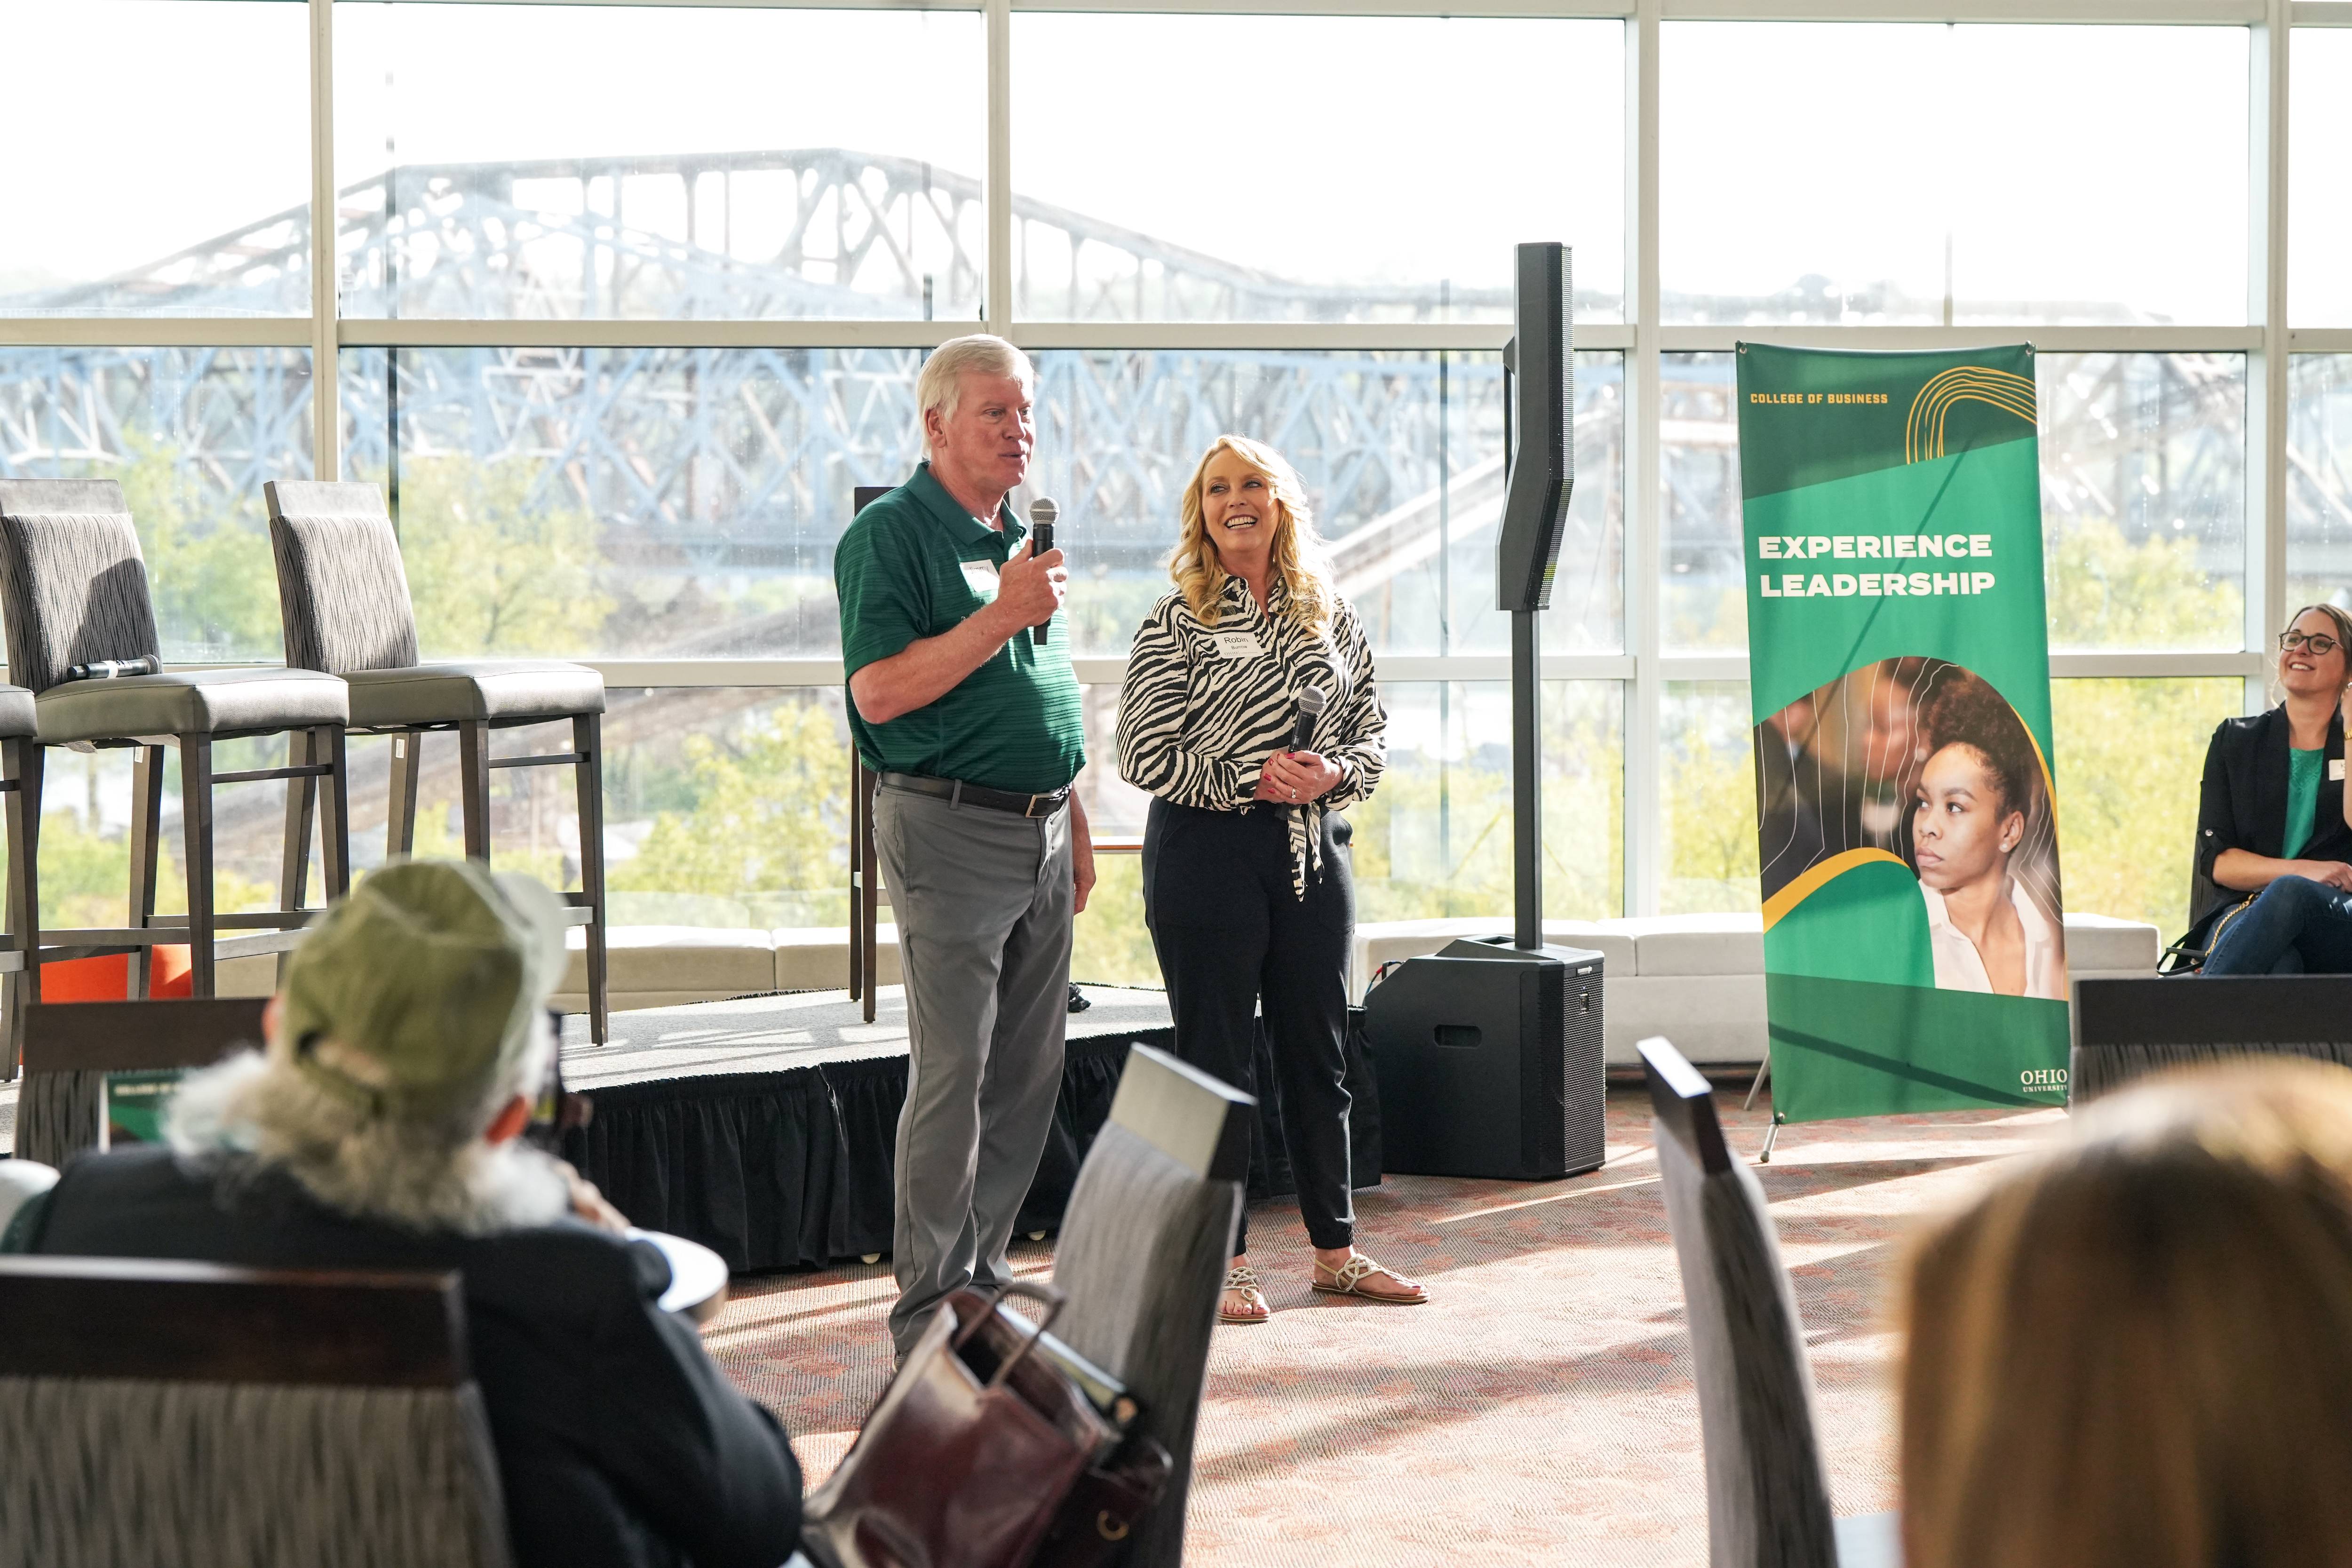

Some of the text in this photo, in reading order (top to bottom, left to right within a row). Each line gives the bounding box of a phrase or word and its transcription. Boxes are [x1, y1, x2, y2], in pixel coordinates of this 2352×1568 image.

[1750, 393, 1888, 404] COLLEGE OF BUSINESS
[1758, 534, 1993, 559] EXPERIENCE
[1760, 572, 1996, 597] LEADERSHIP
[2021, 1069, 2067, 1085] OHIO
